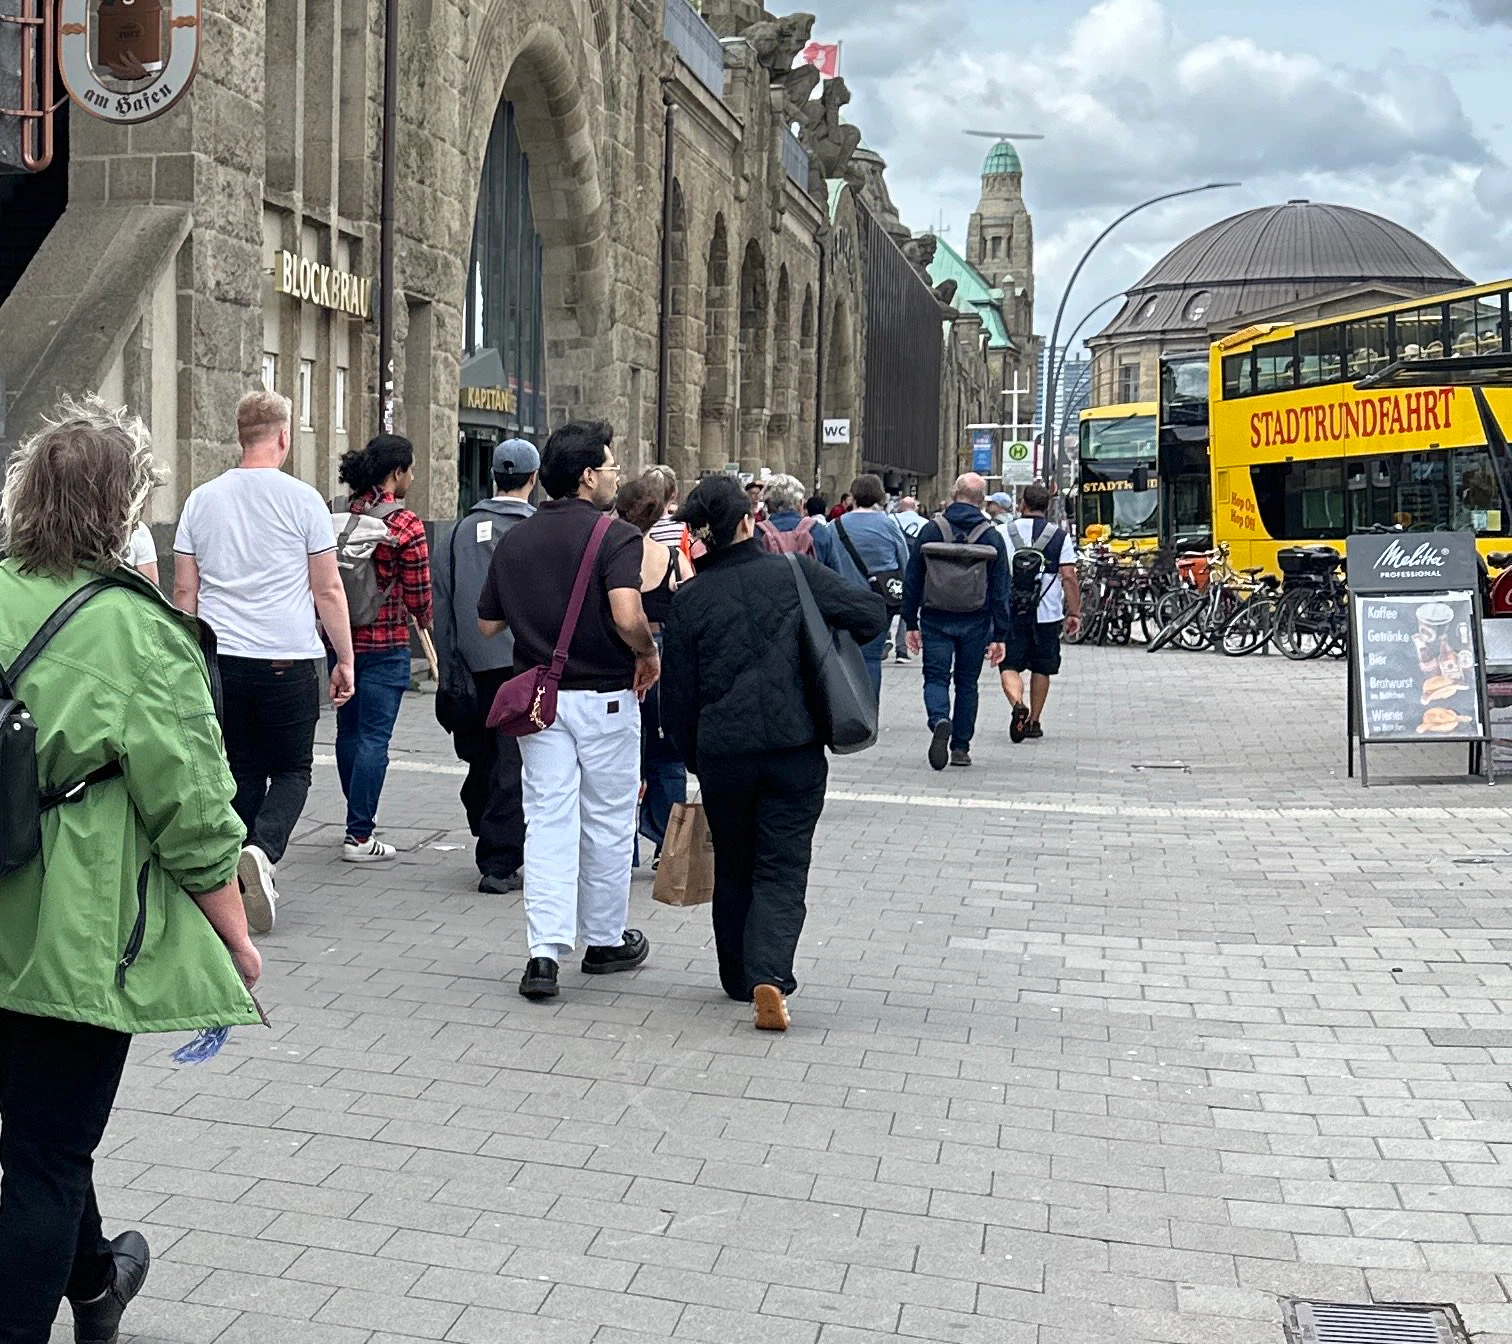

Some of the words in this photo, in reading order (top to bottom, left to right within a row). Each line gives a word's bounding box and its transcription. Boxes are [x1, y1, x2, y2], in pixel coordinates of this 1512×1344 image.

[83, 88, 110, 110] am
[115, 83, 173, 116] Hafen
[283, 249, 371, 318] BLOCKBRÄU
[1250, 386, 1456, 449] STADTRUNDFAHRT
[824, 425, 847, 437] WC
[1373, 539, 1446, 570] Melitta
[1379, 570, 1443, 579] PROFESSIONAL
[1367, 606, 1398, 620] Kaffee
[1367, 629, 1410, 643] Getränke
[1368, 653, 1387, 666] Bier
[1369, 677, 1414, 690] Bratwurst
[1371, 709, 1404, 722] Wiener
